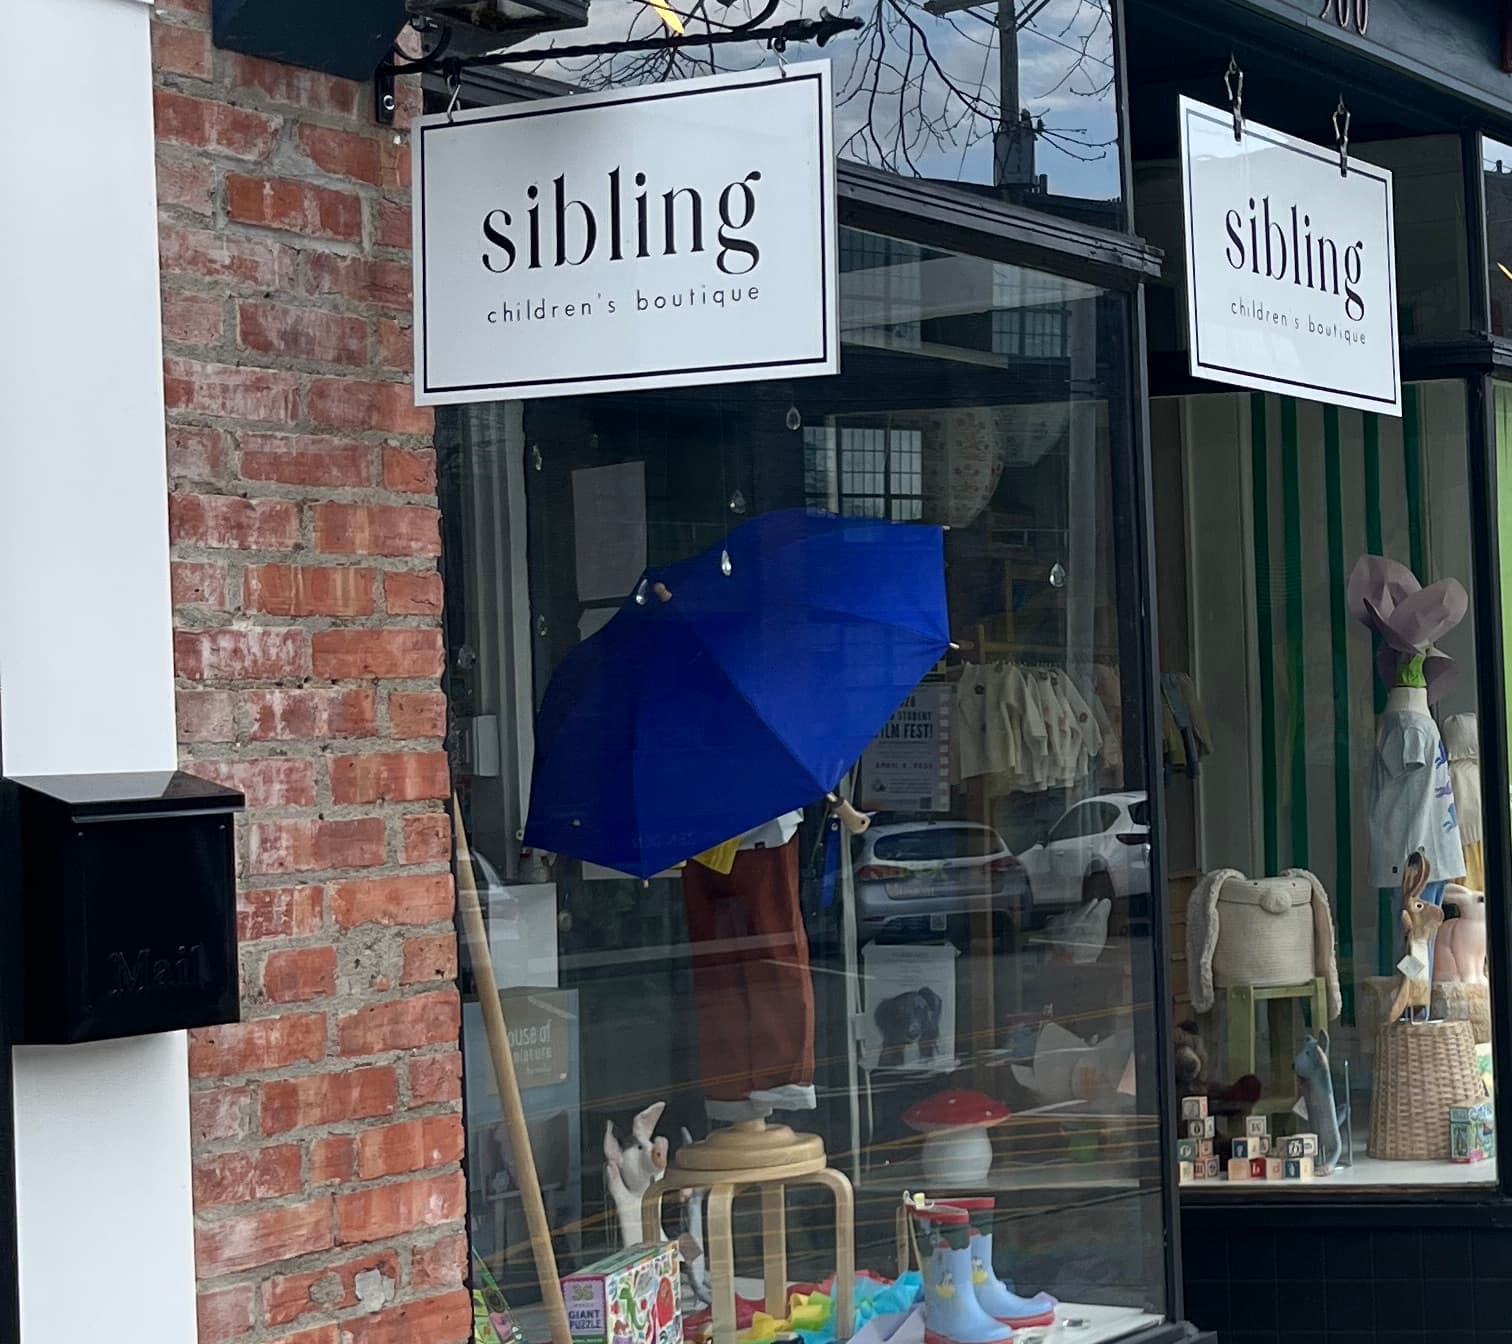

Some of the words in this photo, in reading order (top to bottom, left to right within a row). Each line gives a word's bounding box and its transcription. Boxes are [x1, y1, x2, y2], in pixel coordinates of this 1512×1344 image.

[482, 164, 762, 275] sibling
[1224, 195, 1365, 322] sibling
[486, 293, 617, 325] children's
[636, 283, 761, 312] boutique
[1307, 312, 1368, 346] boutique
[903, 723, 934, 739] FEST!
[108, 943, 204, 994] Mail
[507, 1025, 537, 1048] ouse
[568, 1309, 601, 1321] GIANT
[569, 1319, 602, 1331] PUZZLE
